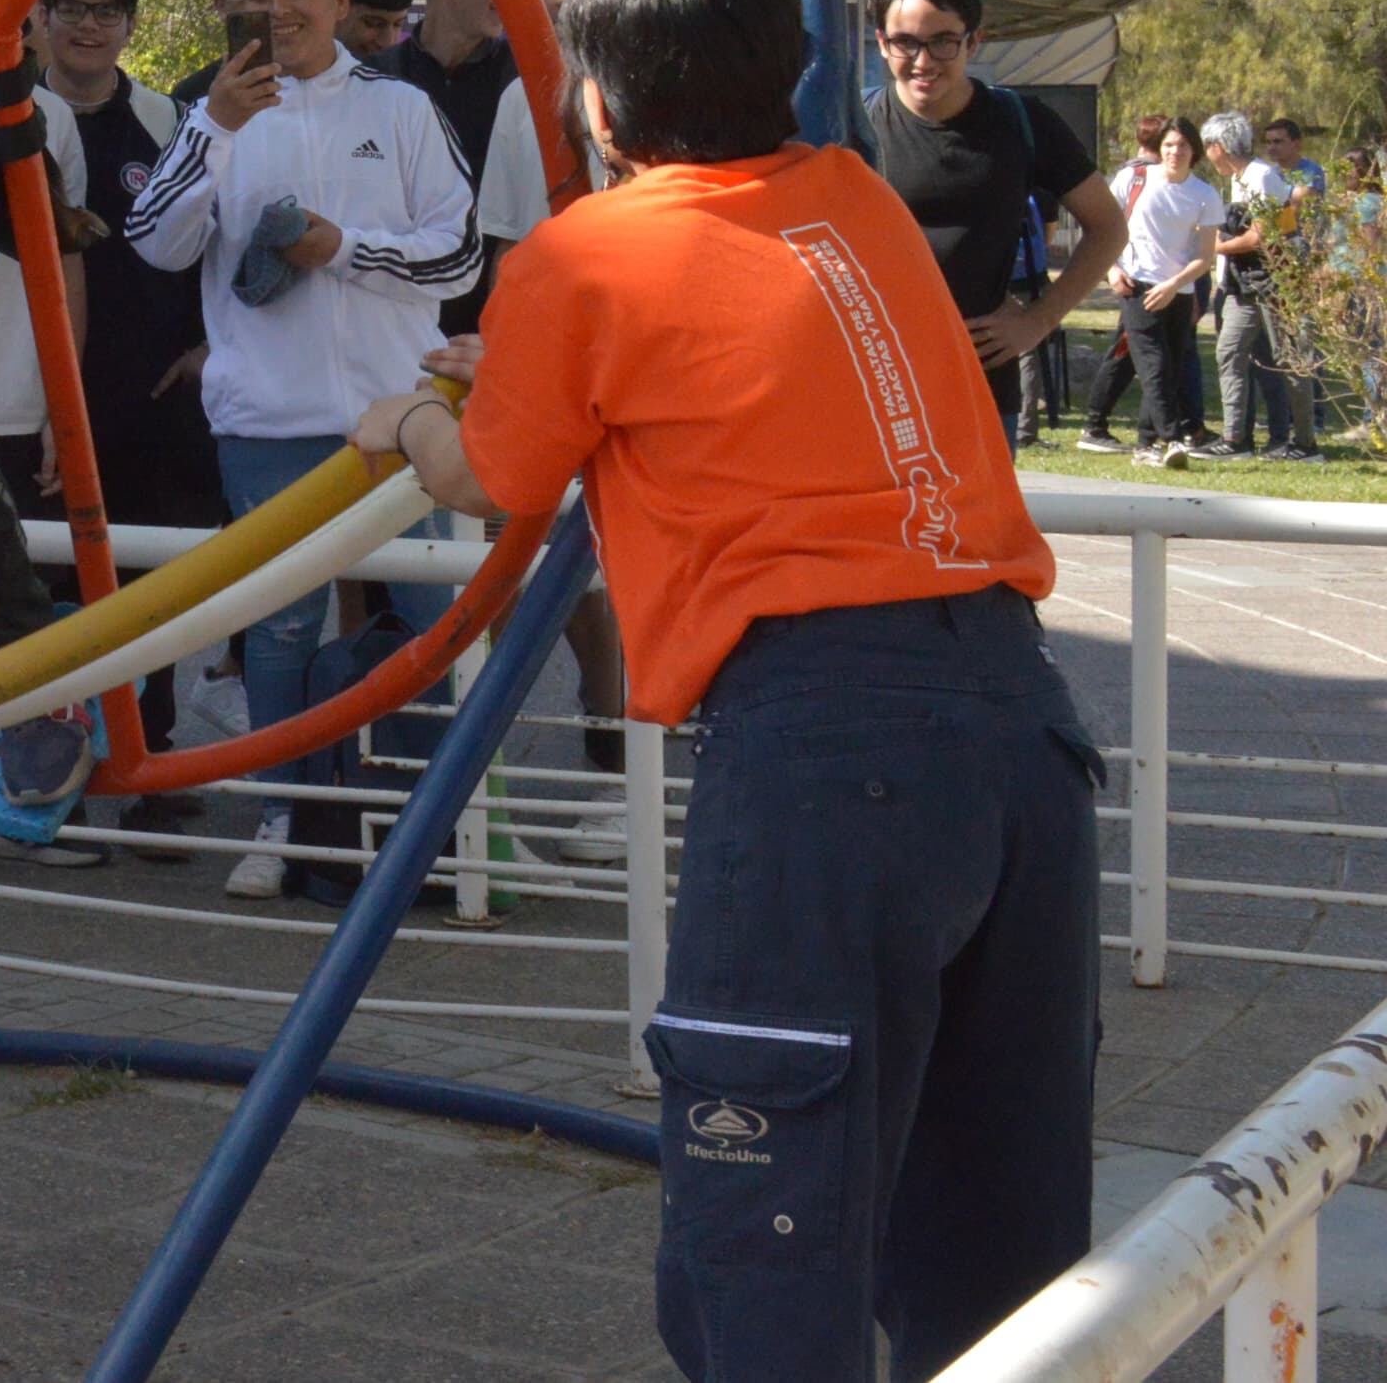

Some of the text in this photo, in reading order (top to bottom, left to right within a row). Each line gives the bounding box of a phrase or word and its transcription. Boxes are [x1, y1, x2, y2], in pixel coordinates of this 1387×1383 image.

[351, 151, 385, 160] adidas
[808, 242, 897, 418] FACULTAD DE CIENCIAS
[820, 239, 911, 415] EXACTAS Y NATURALES
[686, 1142, 772, 1165] EfectoUno
